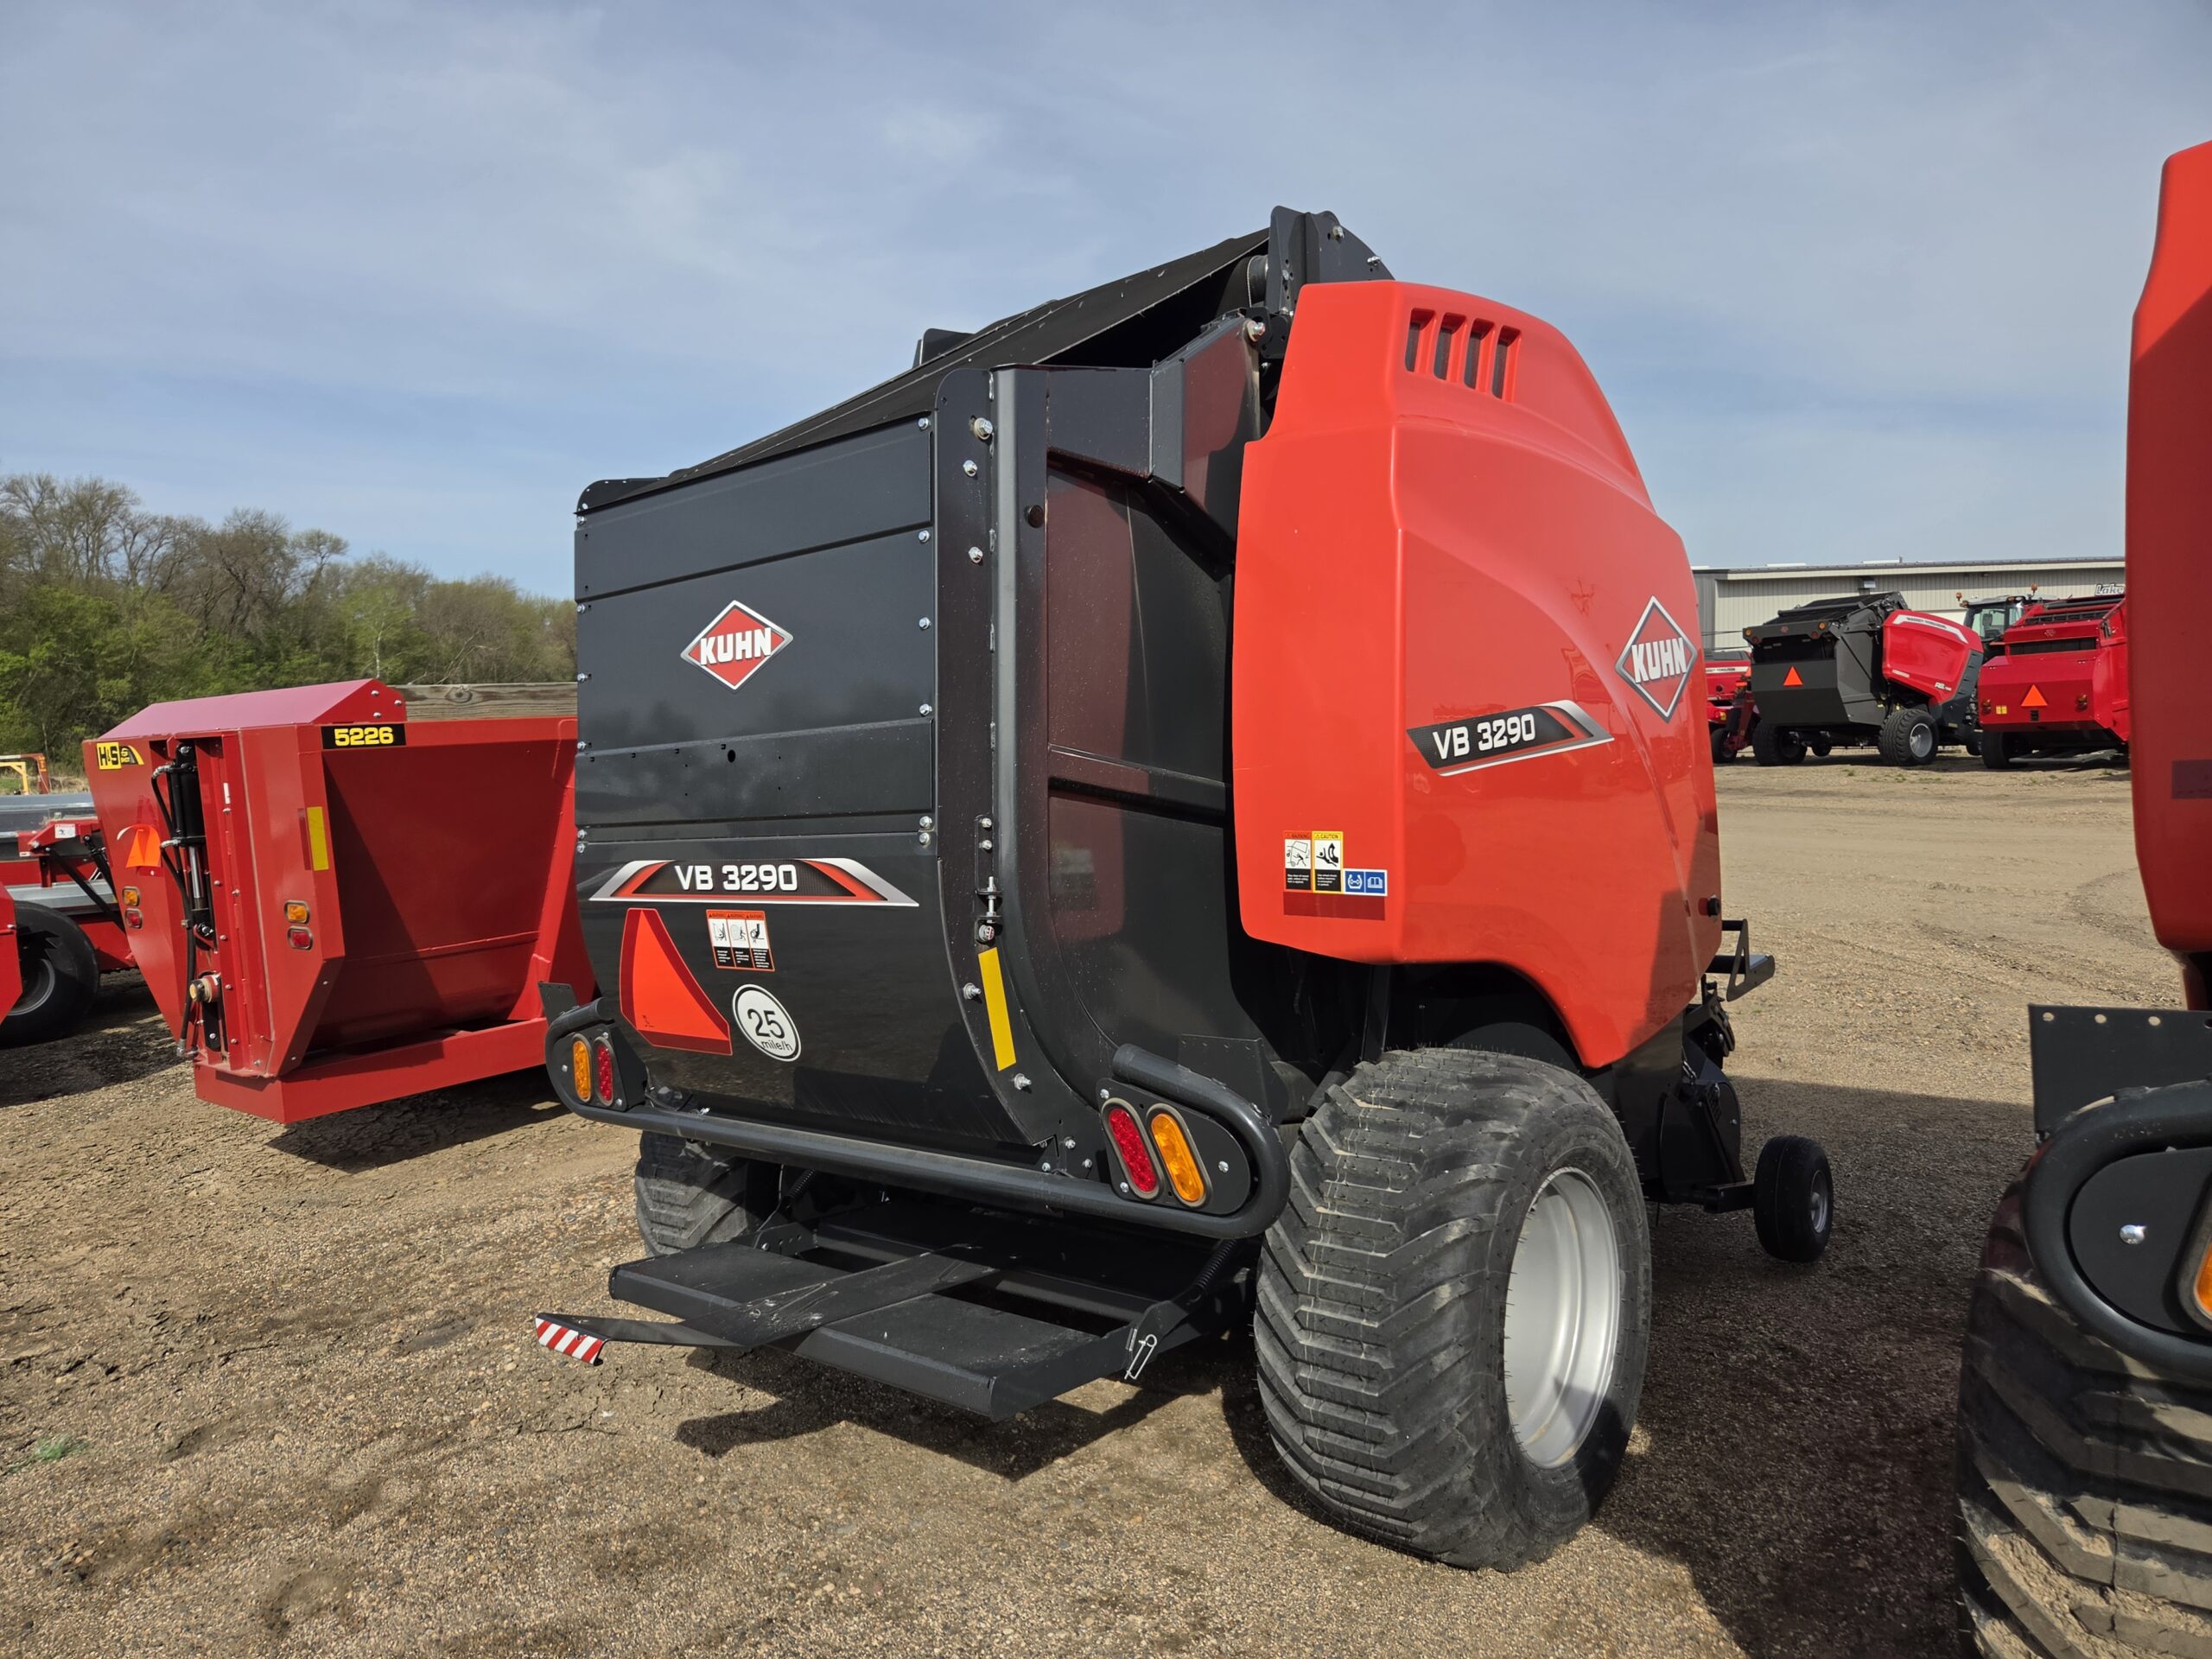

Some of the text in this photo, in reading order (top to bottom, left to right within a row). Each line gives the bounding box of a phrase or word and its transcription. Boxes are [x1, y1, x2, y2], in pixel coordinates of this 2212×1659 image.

[2094, 583, 2125, 595] Lake
[701, 627, 772, 665] KUHN
[1631, 637, 1688, 683] KUHN
[334, 727, 394, 747] 5226
[1433, 713, 1535, 760] VB 3290
[674, 864, 798, 891] VB 3290
[747, 1008, 785, 1039] 25
[761, 1039, 793, 1052] mile/h
